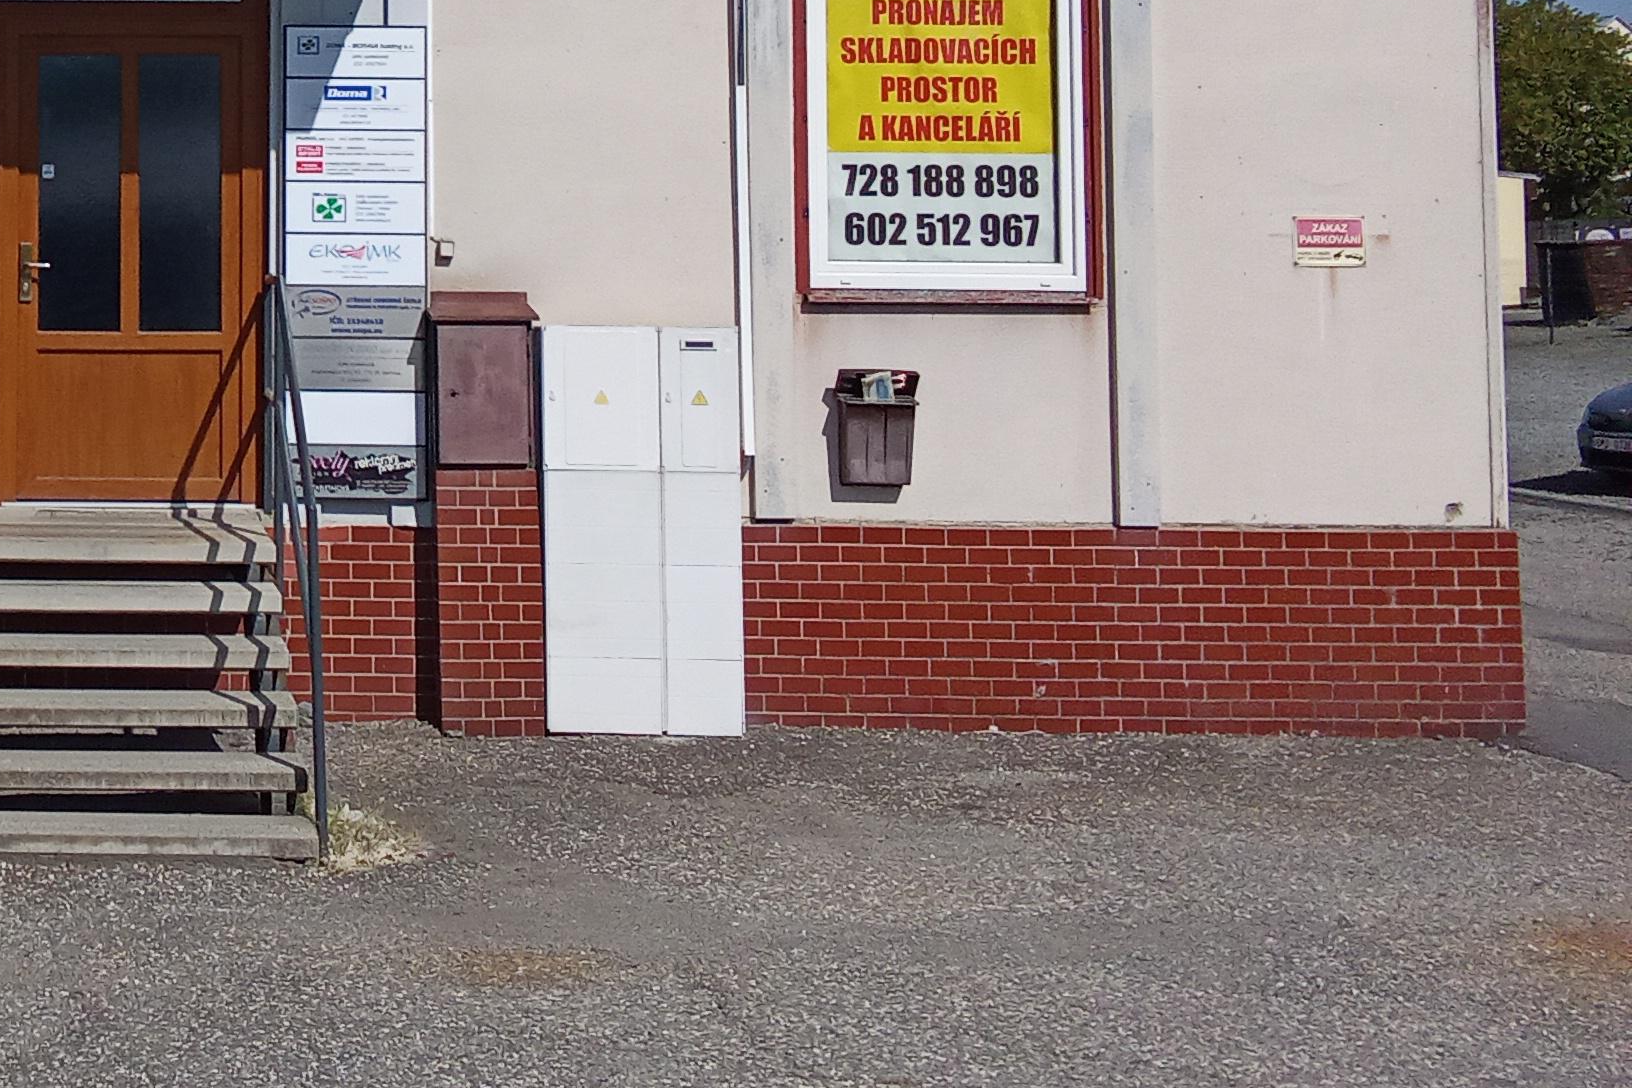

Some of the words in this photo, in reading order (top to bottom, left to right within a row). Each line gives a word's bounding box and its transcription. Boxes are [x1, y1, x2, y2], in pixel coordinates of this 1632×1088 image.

[840, 34, 1036, 64] SKLADOVACÍCH
[326, 88, 368, 99] Doma
[880, 76, 998, 103] PROSTOR
[858, 115, 876, 141] A
[881, 111, 1022, 142] KANCELÁŘÍ
[841, 164, 899, 197] 728
[906, 164, 966, 198] 188
[974, 165, 1039, 198] 898
[844, 212, 907, 246] 602
[916, 213, 972, 246] 512
[979, 214, 1040, 247] 967
[1299, 233, 1361, 244] PARKOVÁNÍ
[1311, 221, 1348, 233] ZÁKAZ
